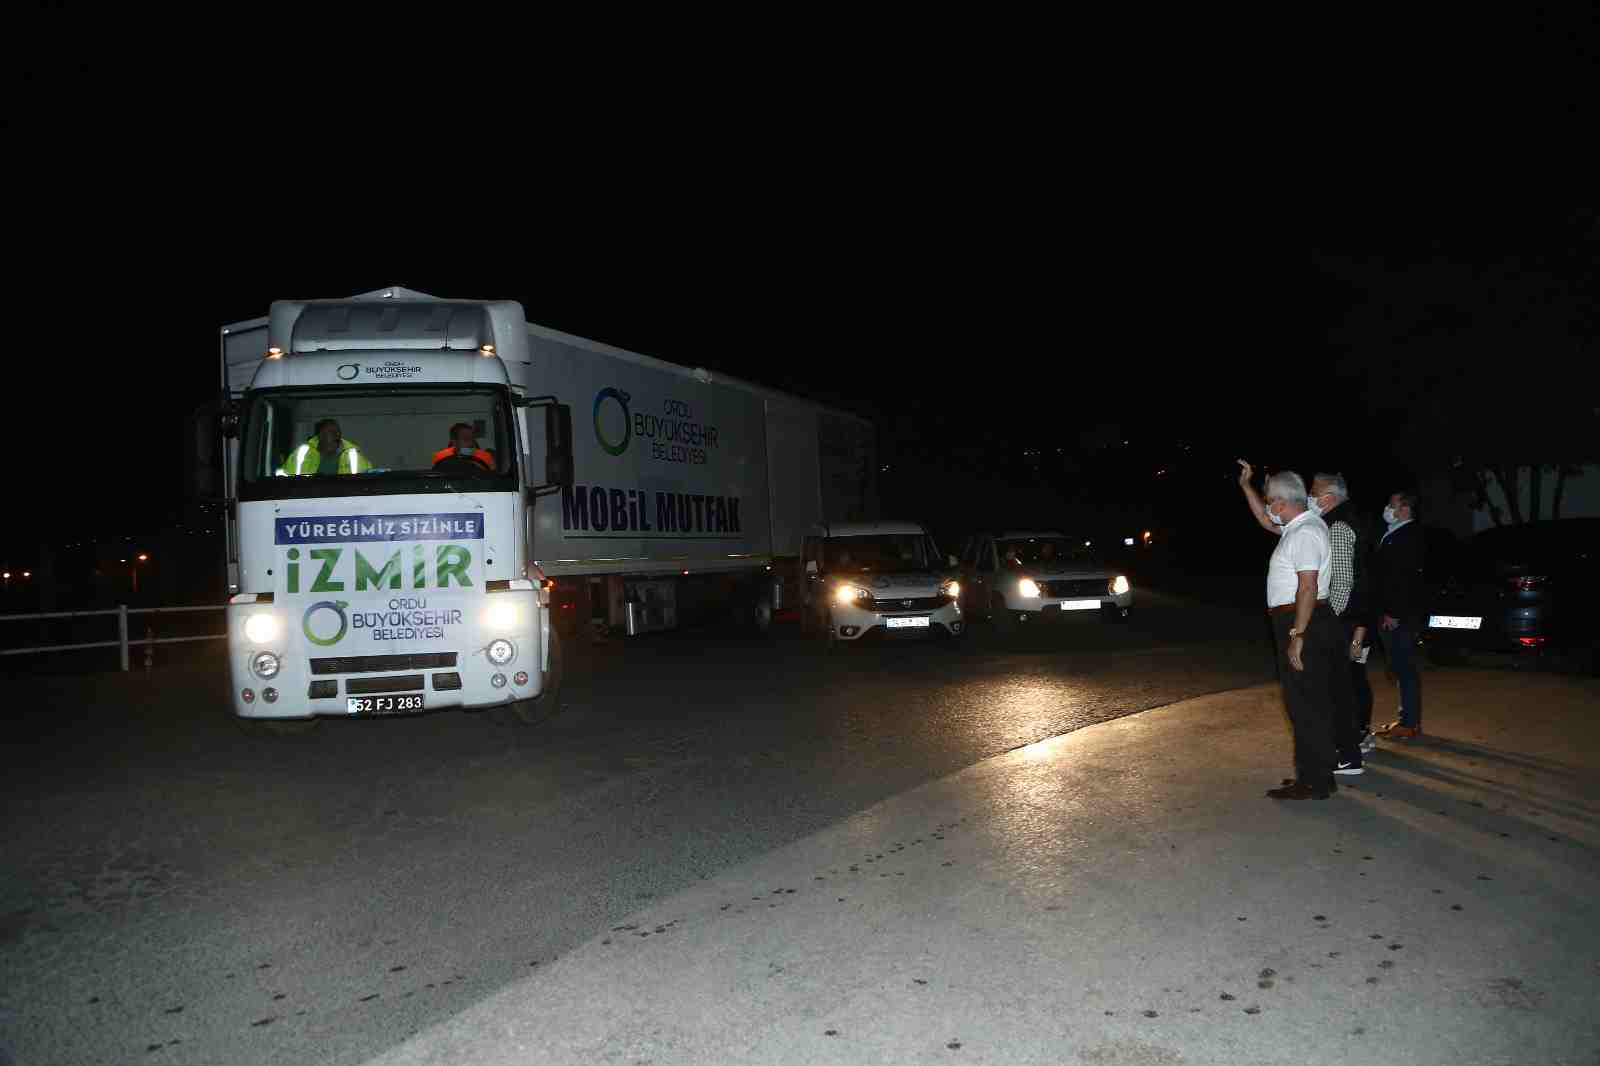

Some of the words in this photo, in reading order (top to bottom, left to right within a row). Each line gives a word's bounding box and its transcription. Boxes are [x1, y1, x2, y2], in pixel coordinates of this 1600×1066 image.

[655, 492, 741, 532] MUTFAK
[285, 517, 395, 538] YÜREĞİMİZ
[401, 517, 476, 535] SİZİNLE
[388, 598, 426, 610] ORDU
[356, 699, 373, 712] 52
[376, 698, 393, 711] FJ
[397, 696, 422, 710] 283
